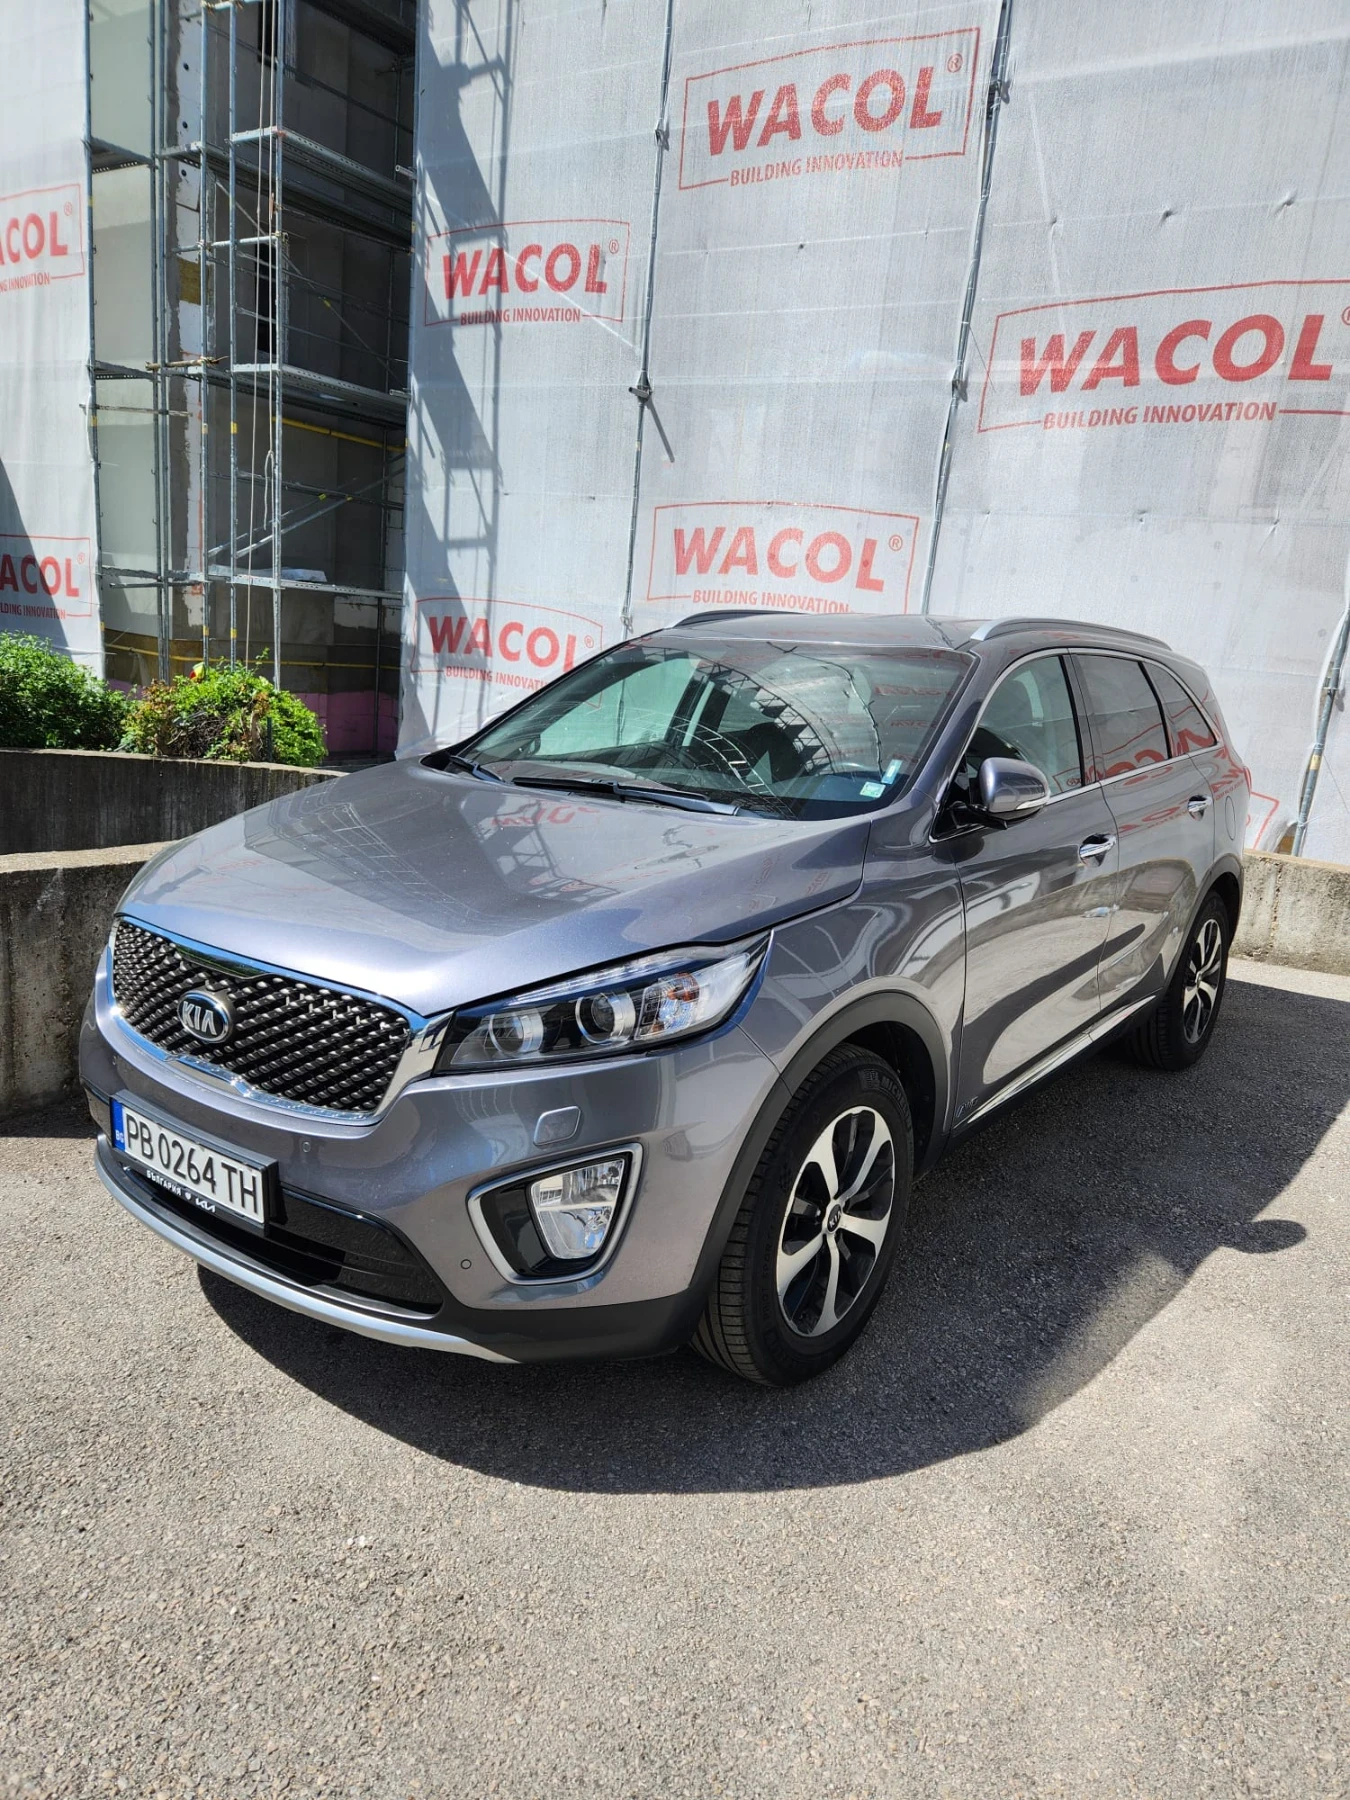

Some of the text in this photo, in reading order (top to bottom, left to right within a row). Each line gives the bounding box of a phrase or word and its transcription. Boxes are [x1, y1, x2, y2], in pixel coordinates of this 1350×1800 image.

[730, 149, 904, 187] BUILDING INNOVATION
[0, 211, 68, 266] COL
[460, 307, 581, 326] BUILDING INNOVATION
[1043, 401, 1277, 430] BUILDING INNOVATION
[23, 604, 66, 619] INNOVATION
[692, 589, 850, 613] BUILDING INNOVATION
[446, 665, 493, 682] BUILDING
[182, 1001, 217, 1036] KIA
[115, 1129, 125, 1144] BG
[158, 1132, 217, 1195] 0264
